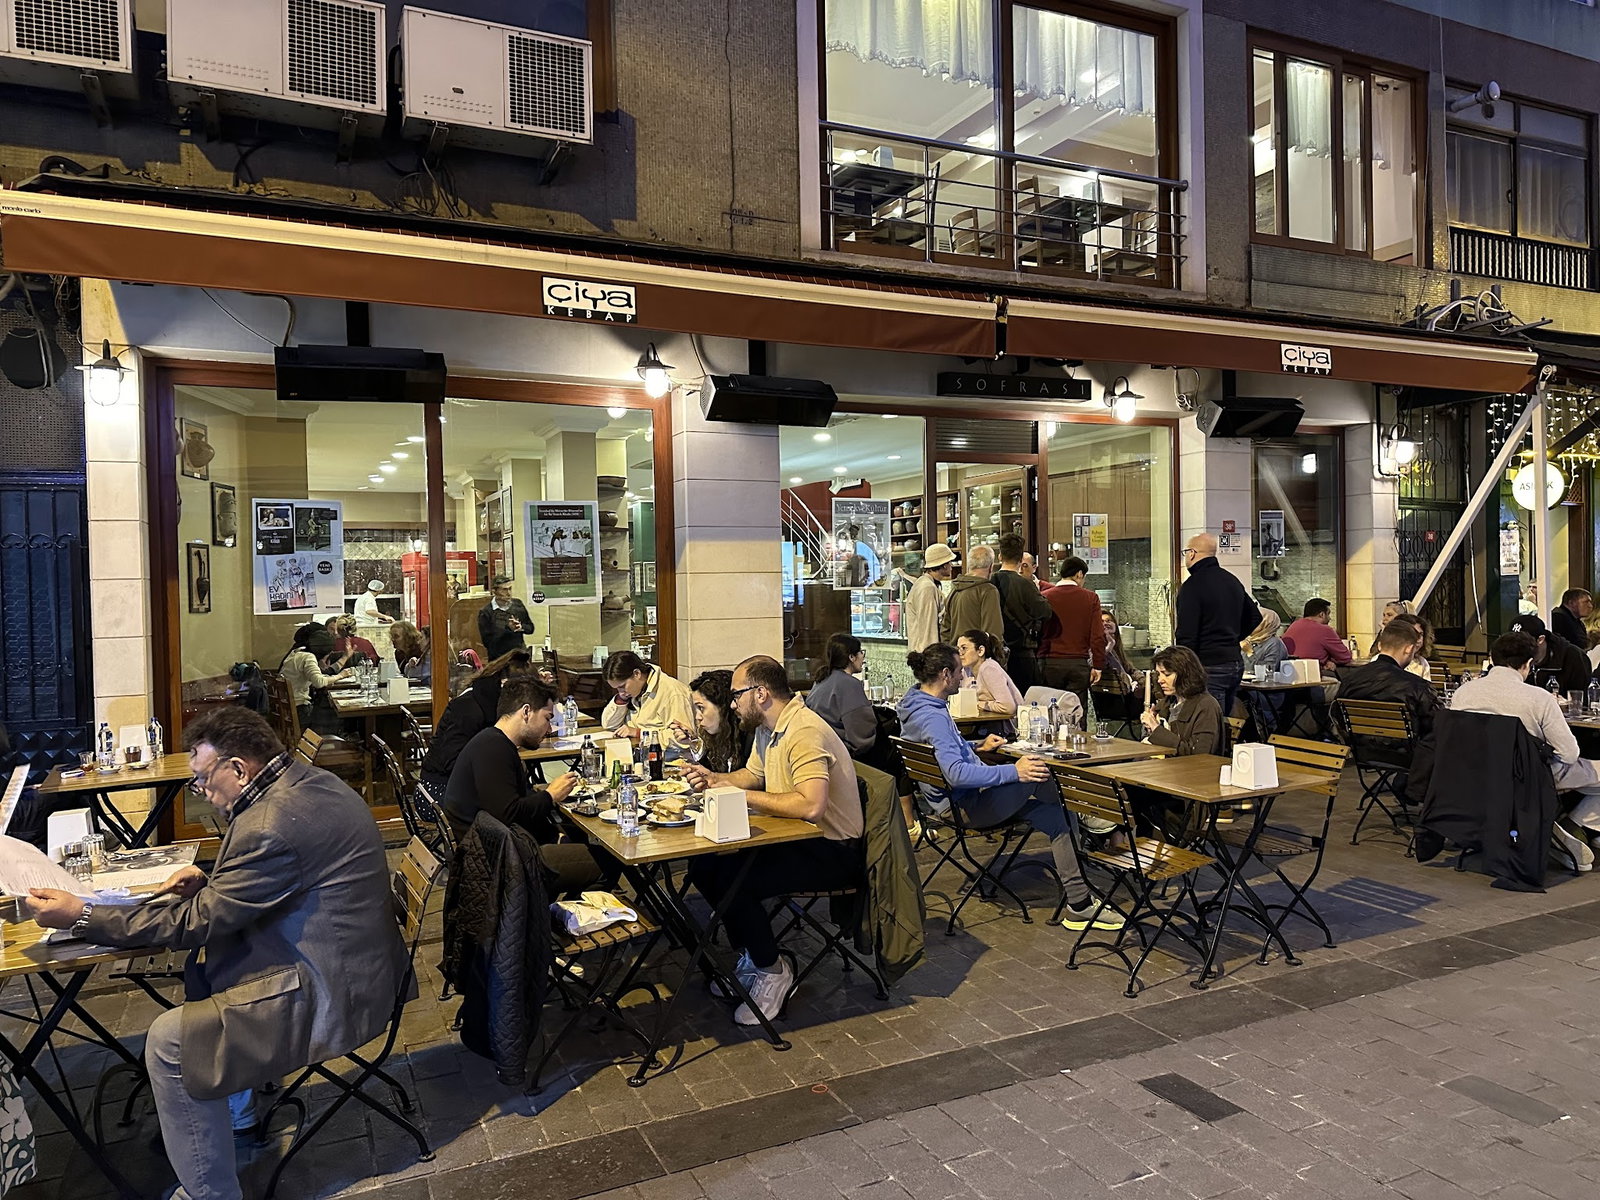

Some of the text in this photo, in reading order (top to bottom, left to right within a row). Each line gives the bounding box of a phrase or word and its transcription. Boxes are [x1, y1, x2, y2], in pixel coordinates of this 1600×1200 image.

[547, 281, 633, 309] çiya
[547, 305, 632, 323] KEBAP
[1284, 346, 1330, 366] çiya
[1283, 365, 1330, 375] KEBAP
[956, 377, 1085, 395] SOFRASI
